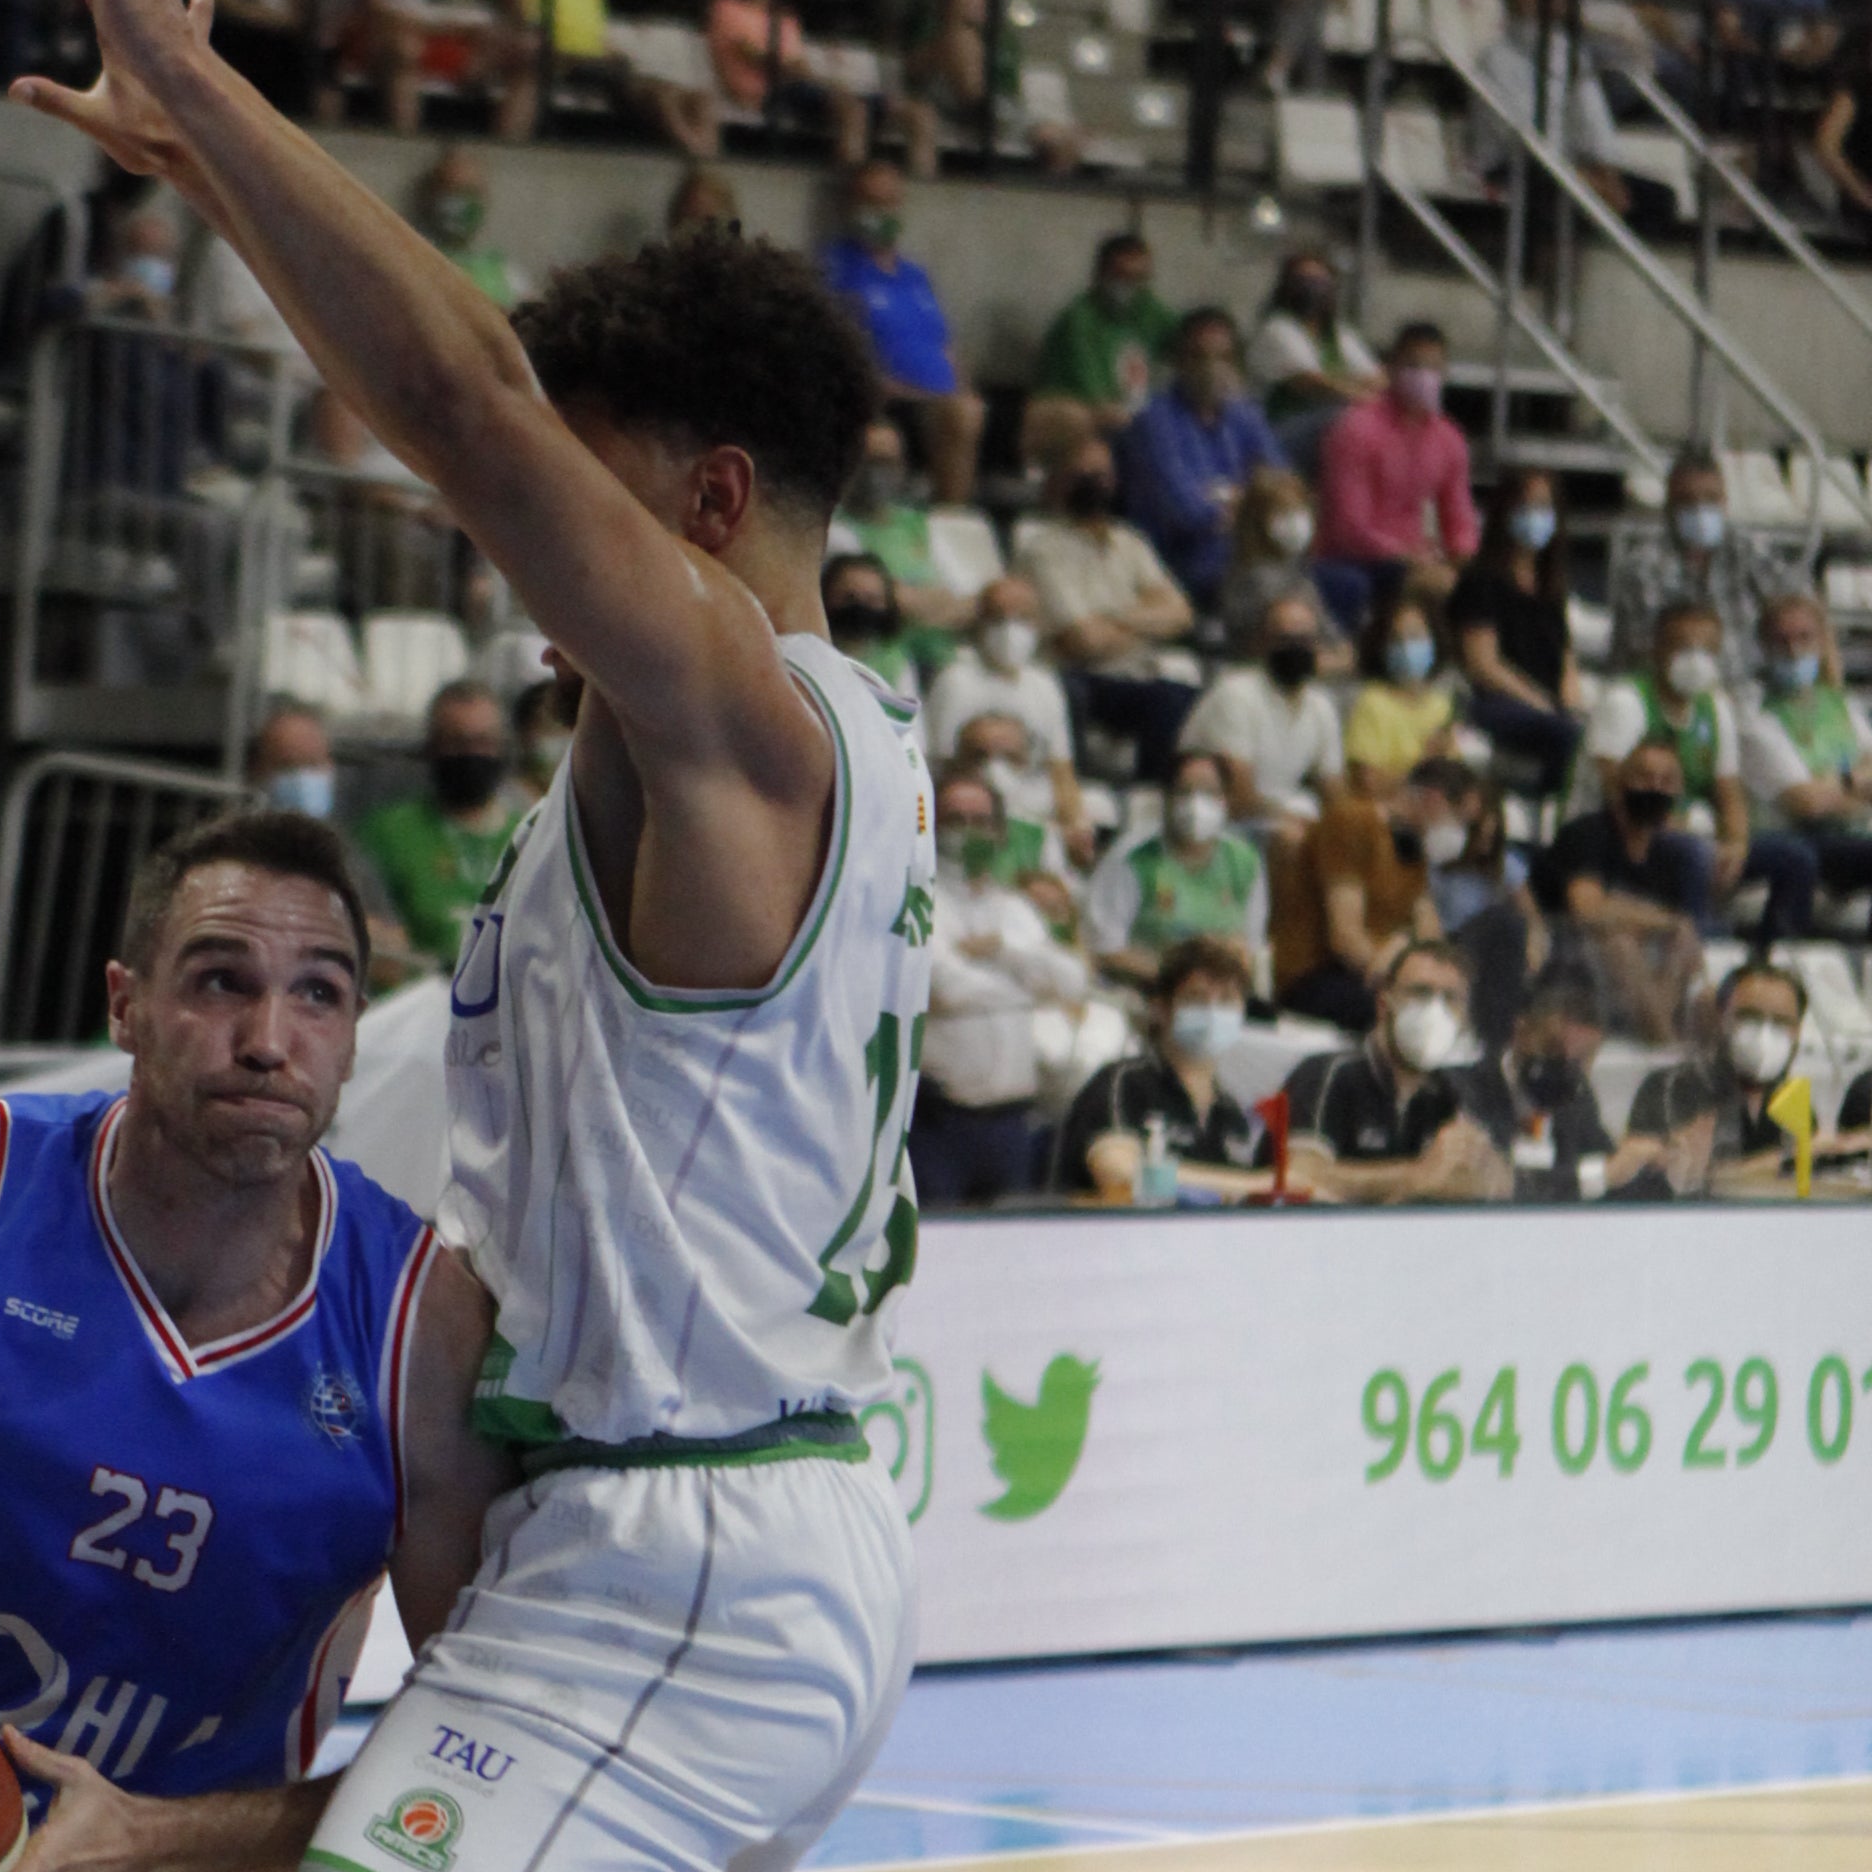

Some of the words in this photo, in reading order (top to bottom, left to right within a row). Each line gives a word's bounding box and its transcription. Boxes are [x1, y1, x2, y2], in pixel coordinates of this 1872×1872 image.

[1360, 1362, 1521, 1485] 964
[1551, 1360, 1653, 1475] 06
[1681, 1356, 1780, 1470] 29
[69, 1464, 215, 1593] 23
[429, 1724, 518, 1782] TAU
